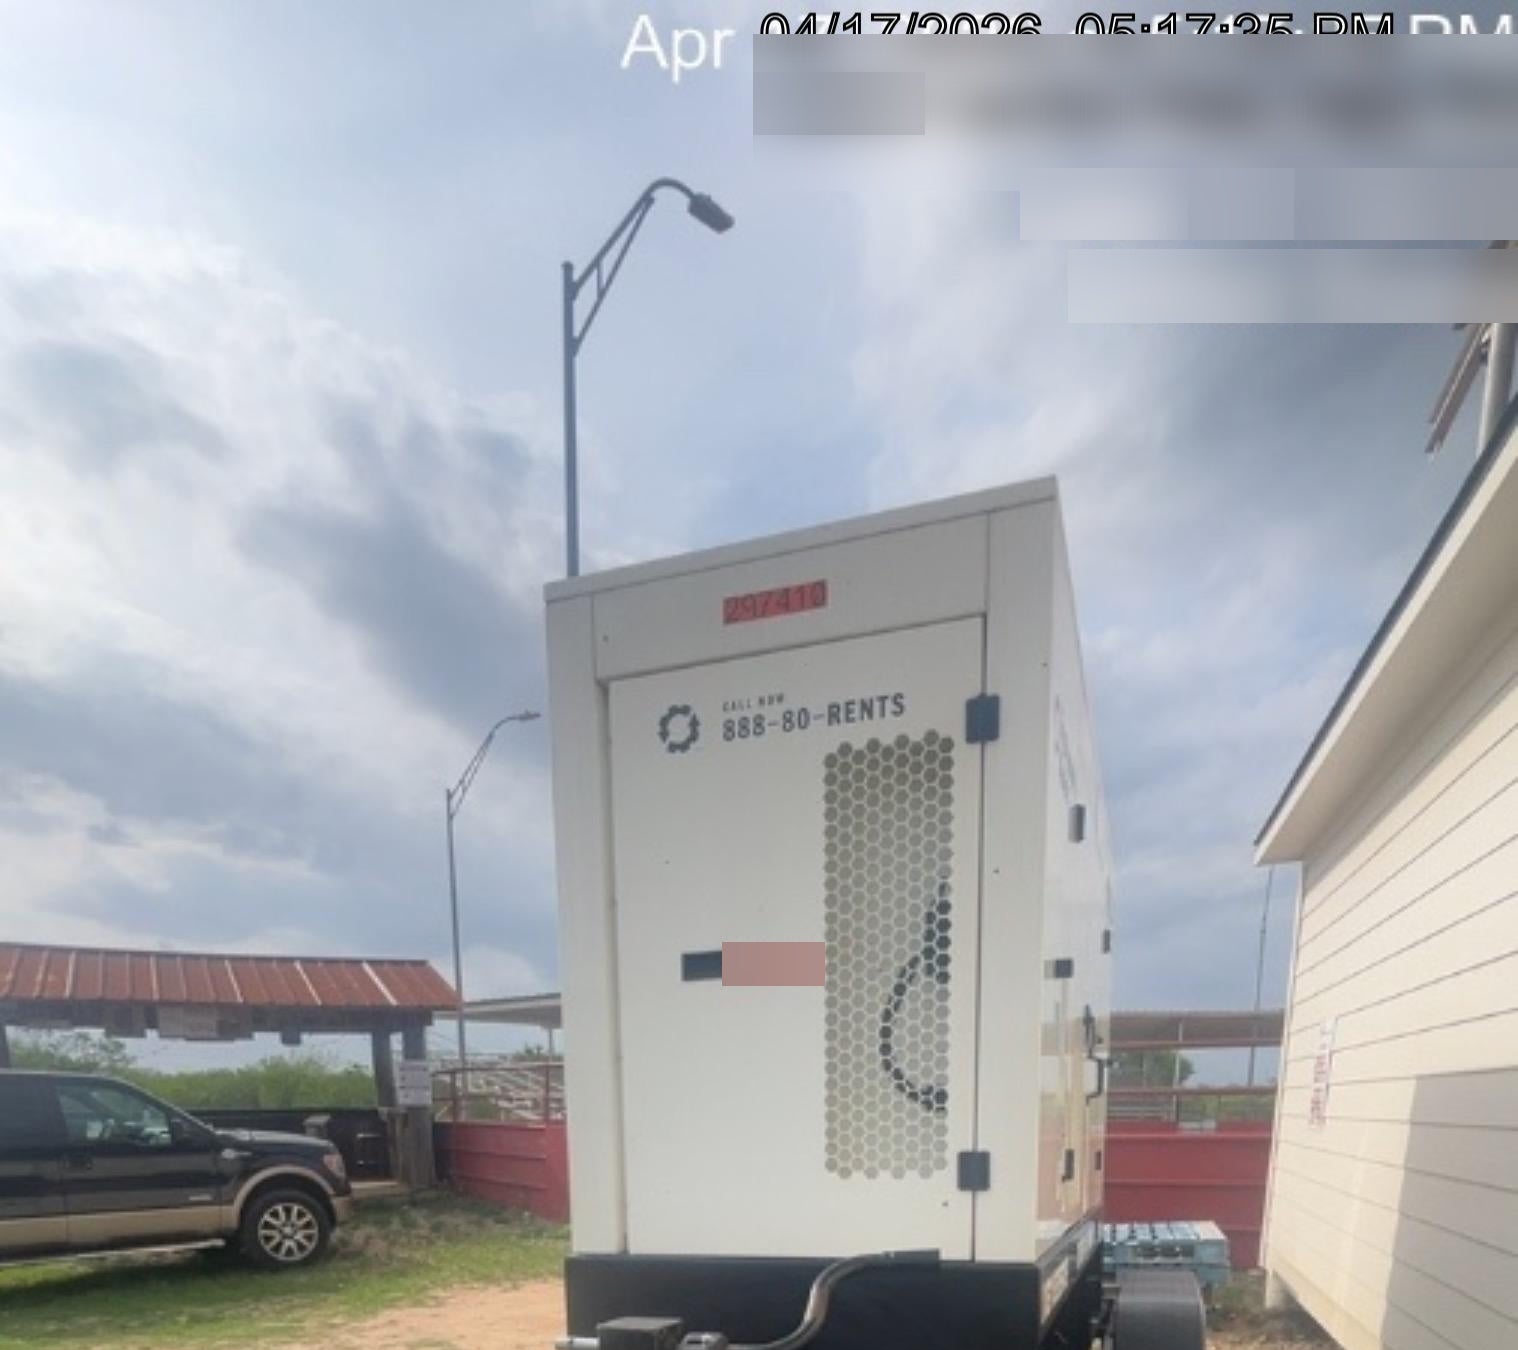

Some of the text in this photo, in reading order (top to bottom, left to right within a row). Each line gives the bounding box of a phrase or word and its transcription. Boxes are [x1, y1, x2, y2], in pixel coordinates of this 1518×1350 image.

[722, 692, 785, 713] CALL NOW
[722, 692, 905, 742] 888-80-RENTS
